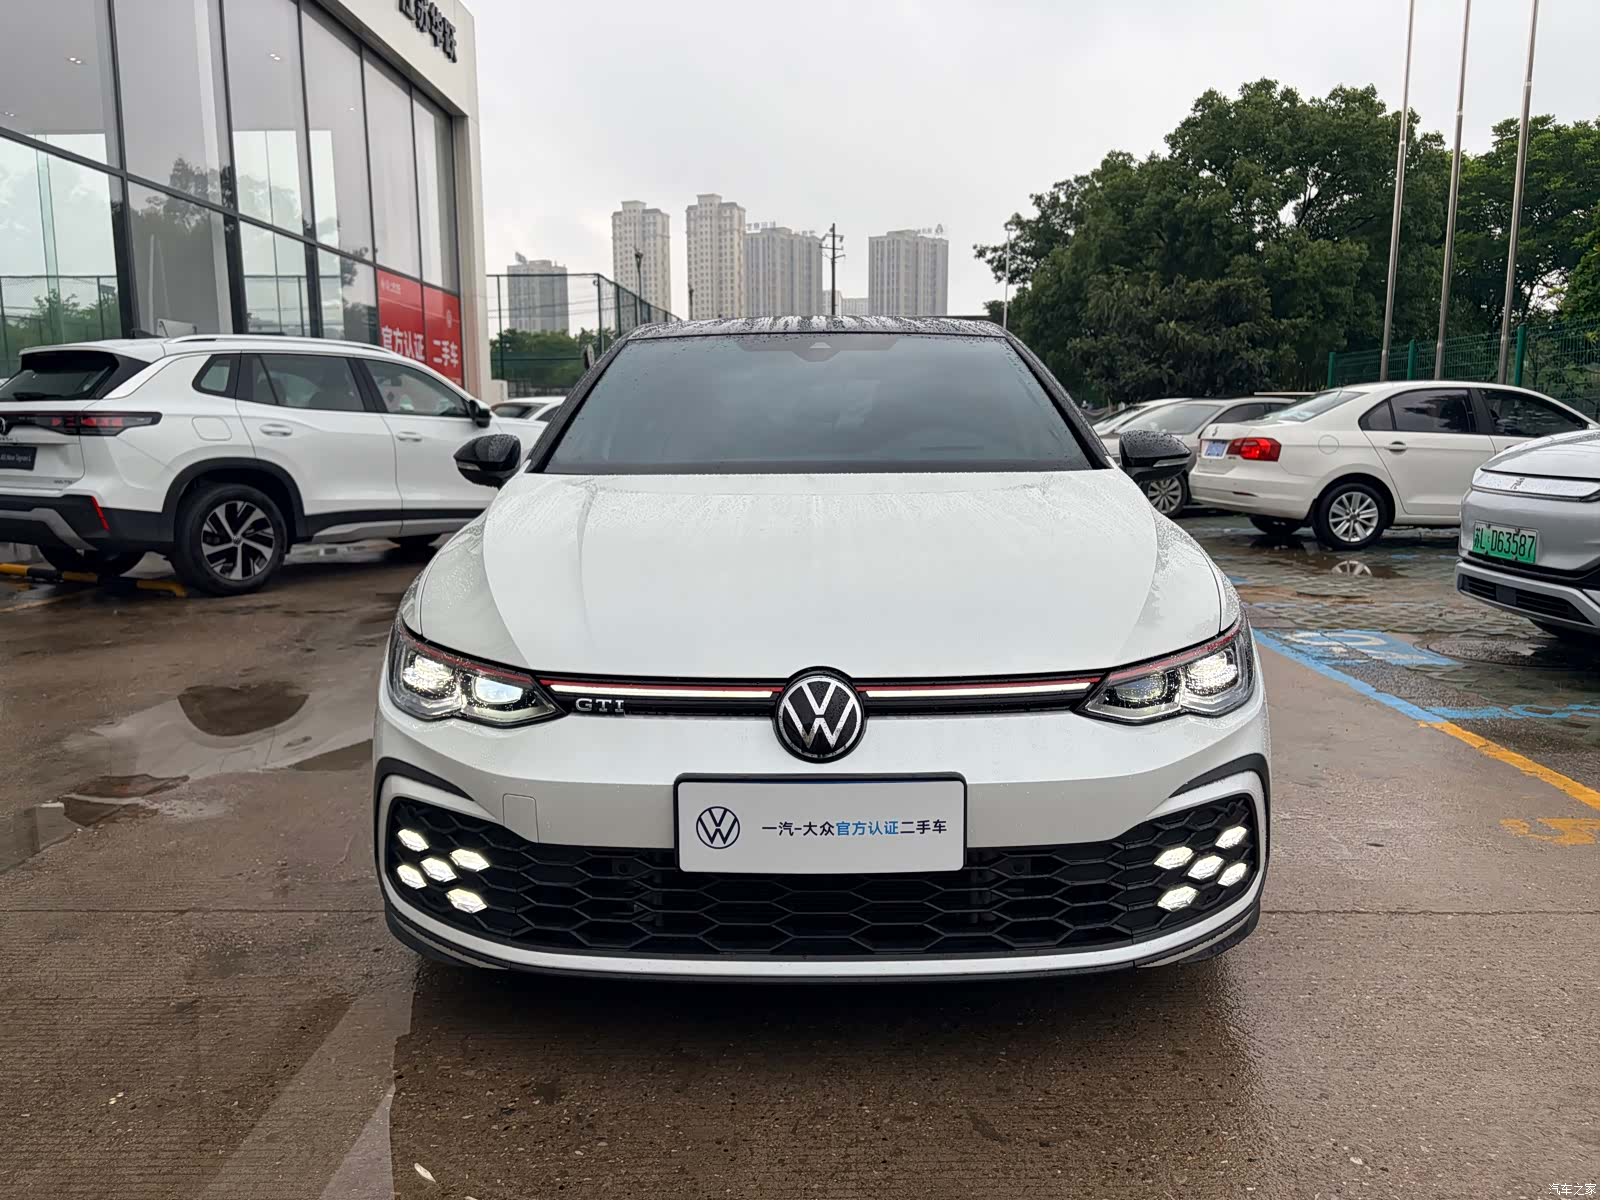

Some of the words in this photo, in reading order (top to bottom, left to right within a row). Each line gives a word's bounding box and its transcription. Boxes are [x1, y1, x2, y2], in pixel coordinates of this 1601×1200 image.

[432, 340, 459, 368] 二手车
[575, 697, 625, 713] GTI
[761, 819, 948, 837] 一汽-大众官方认证二手车
